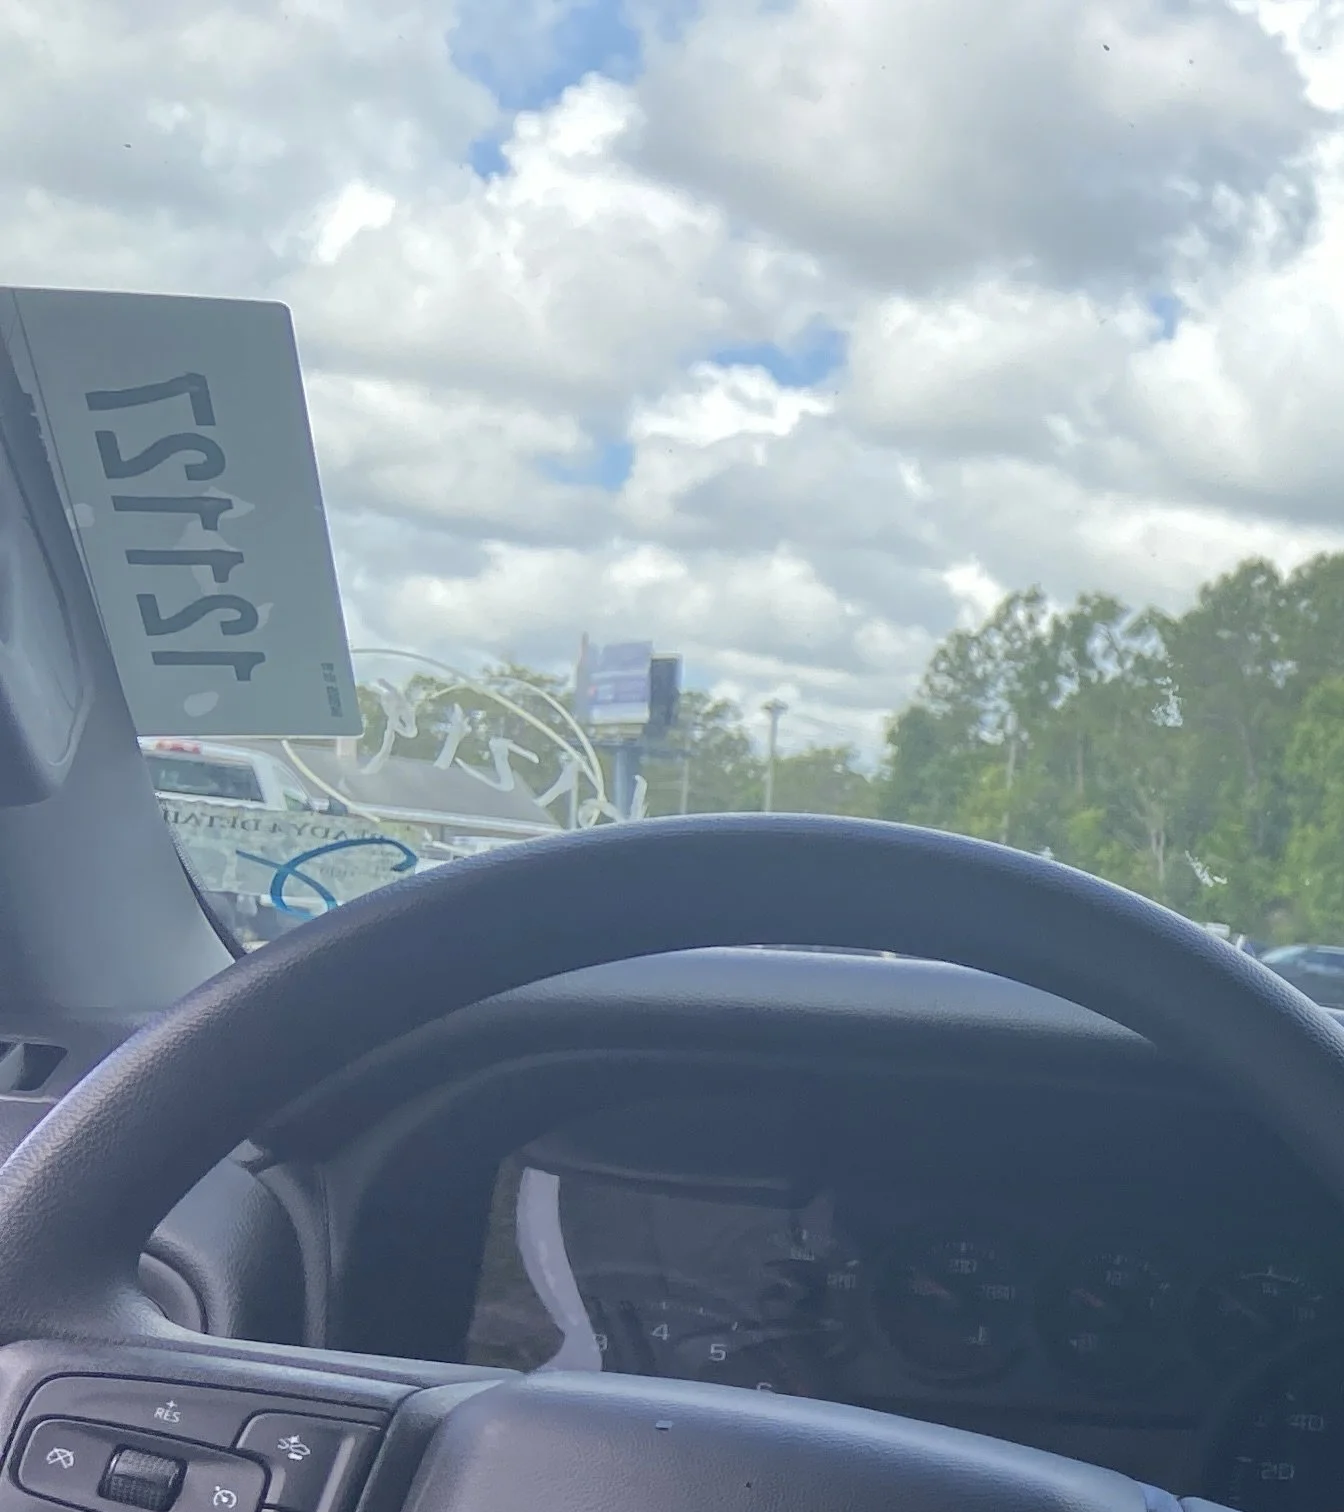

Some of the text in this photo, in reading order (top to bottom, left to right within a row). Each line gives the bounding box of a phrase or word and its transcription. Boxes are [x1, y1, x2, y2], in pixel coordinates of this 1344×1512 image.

[652, 1323, 669, 1341] 4
[709, 1343, 726, 1361] 5
[154, 1407, 181, 1423] RES
